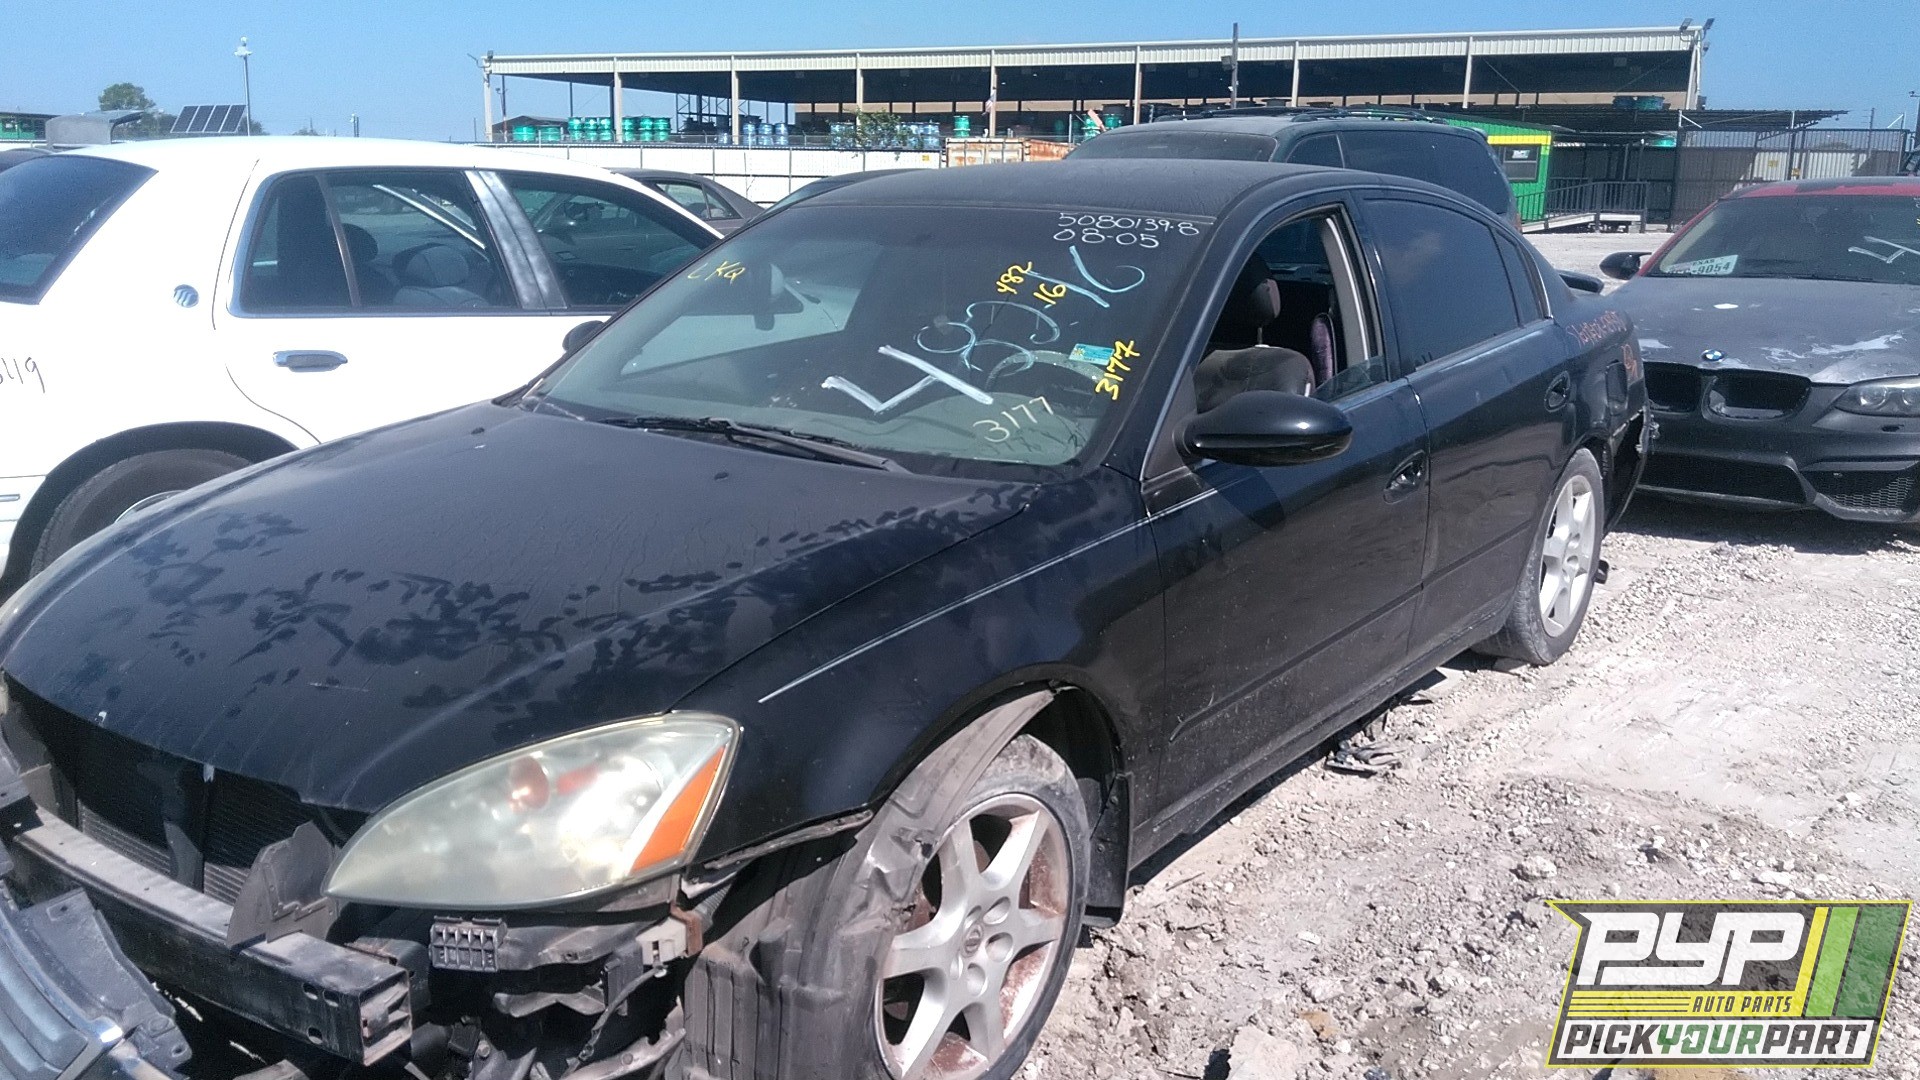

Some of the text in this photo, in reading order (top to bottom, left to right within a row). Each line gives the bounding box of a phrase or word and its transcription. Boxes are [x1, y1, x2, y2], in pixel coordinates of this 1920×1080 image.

[1053, 228, 1159, 249] 08-05
[1033, 283, 1067, 305] 16
[1094, 340, 1141, 400] 3177
[972, 396, 1054, 442] 3177
